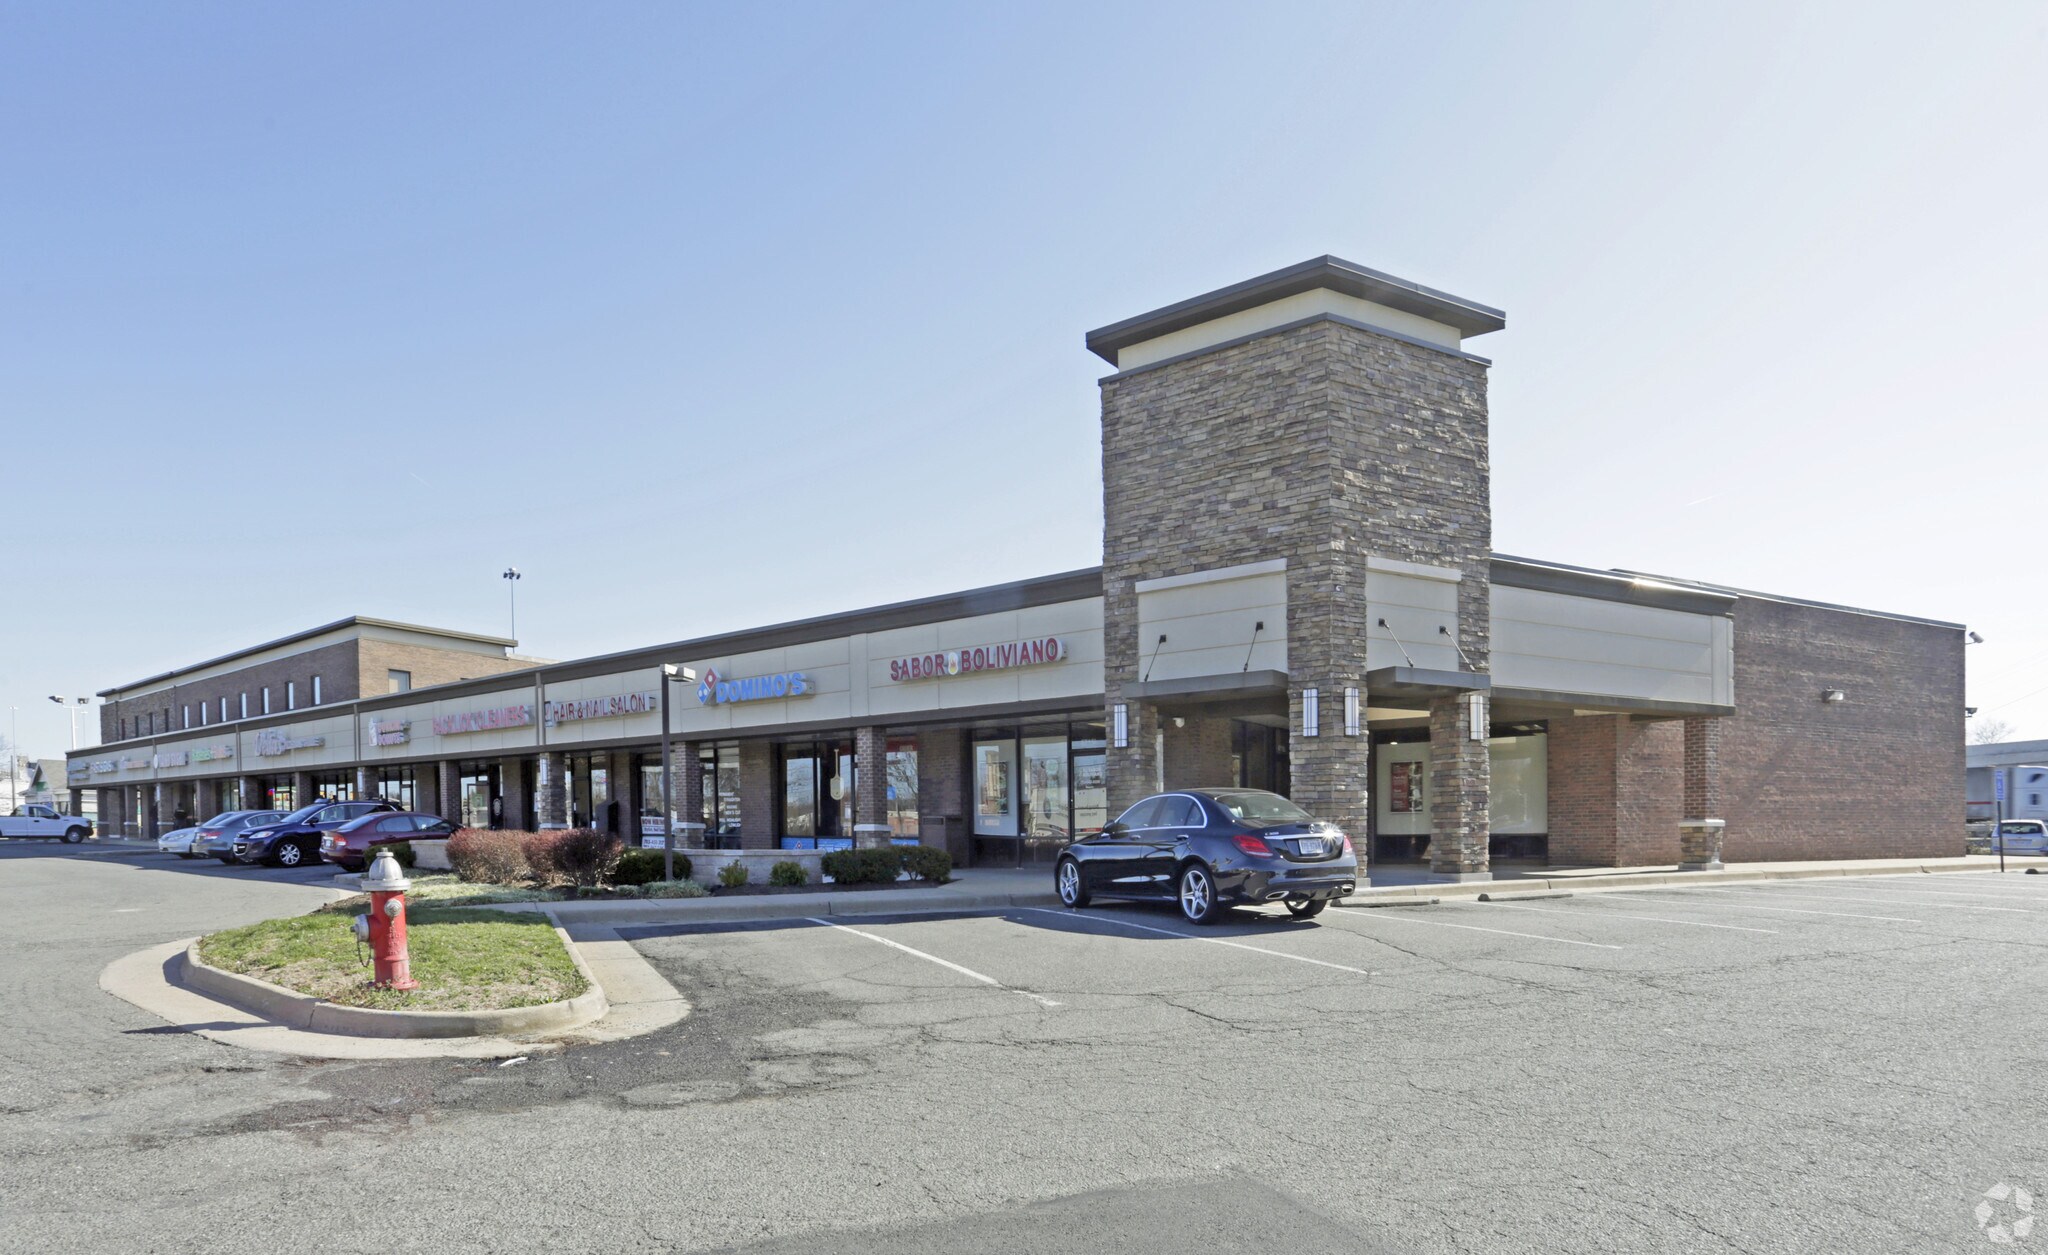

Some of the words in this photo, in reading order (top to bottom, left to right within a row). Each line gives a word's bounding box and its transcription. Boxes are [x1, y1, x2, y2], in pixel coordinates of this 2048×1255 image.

[890, 653, 945, 682] SABOR
[961, 637, 1059, 672] BOLIVIANO
[716, 672, 805, 703] DOMINO'S
[477, 704, 526, 731] CLEANERS
[553, 702, 575, 721] HAIR
[577, 702, 584, 719] &
[610, 692, 646, 715] SALON
